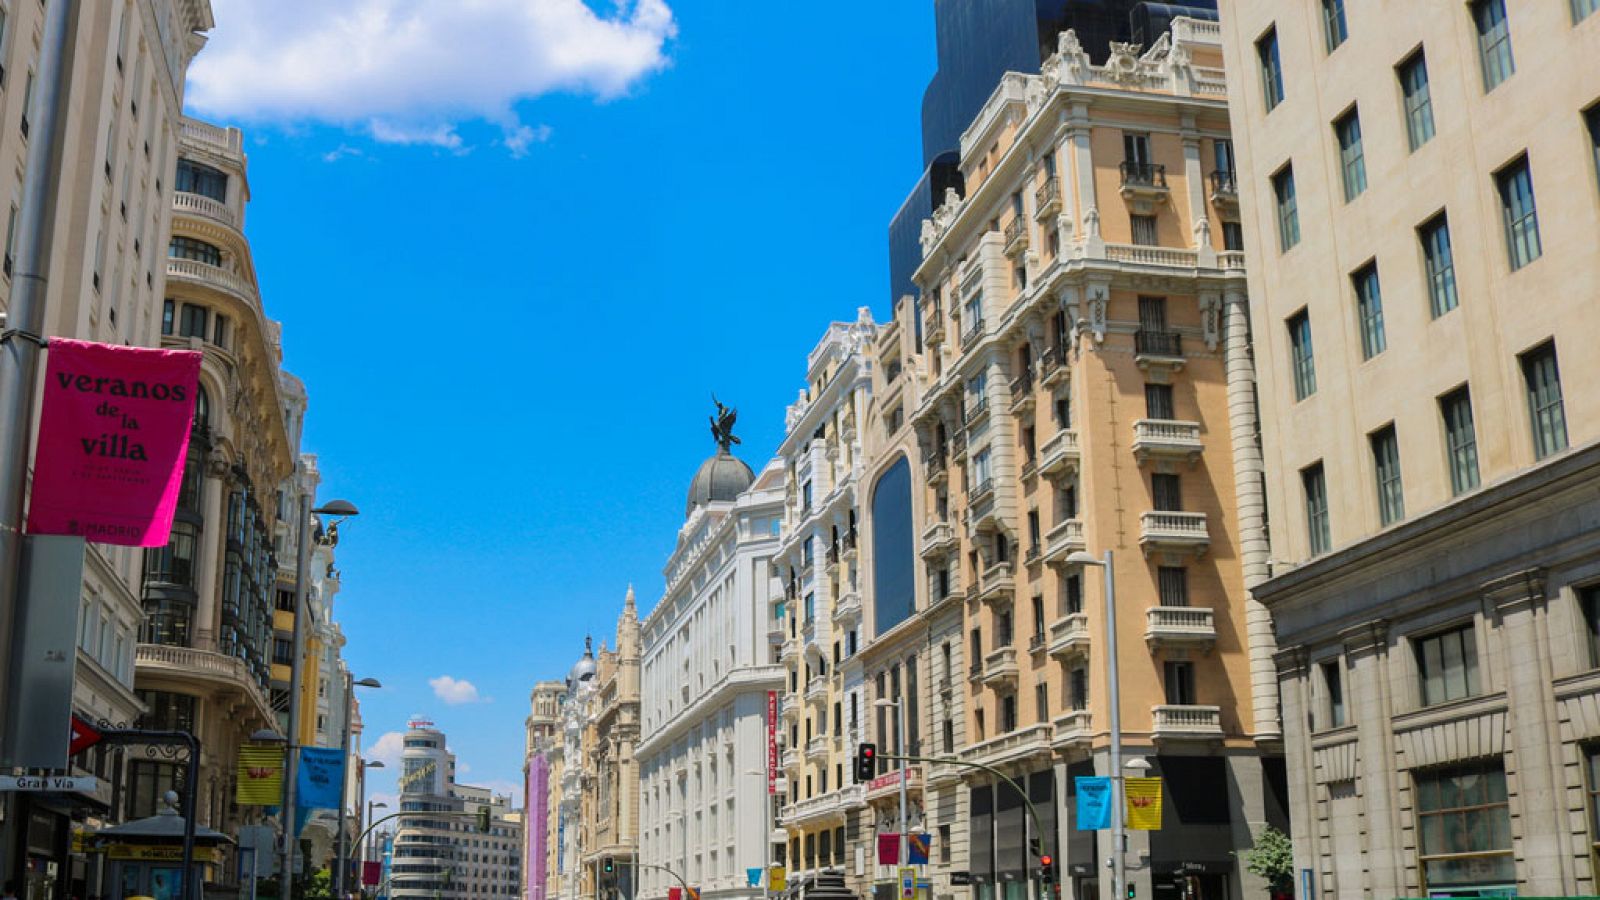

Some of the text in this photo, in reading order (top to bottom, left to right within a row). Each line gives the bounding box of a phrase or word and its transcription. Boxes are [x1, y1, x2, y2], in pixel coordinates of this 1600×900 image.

[57, 372, 187, 402] veranos
[96, 401, 140, 430] de la
[81, 432, 148, 462] villa
[16, 777, 48, 789] Gran
